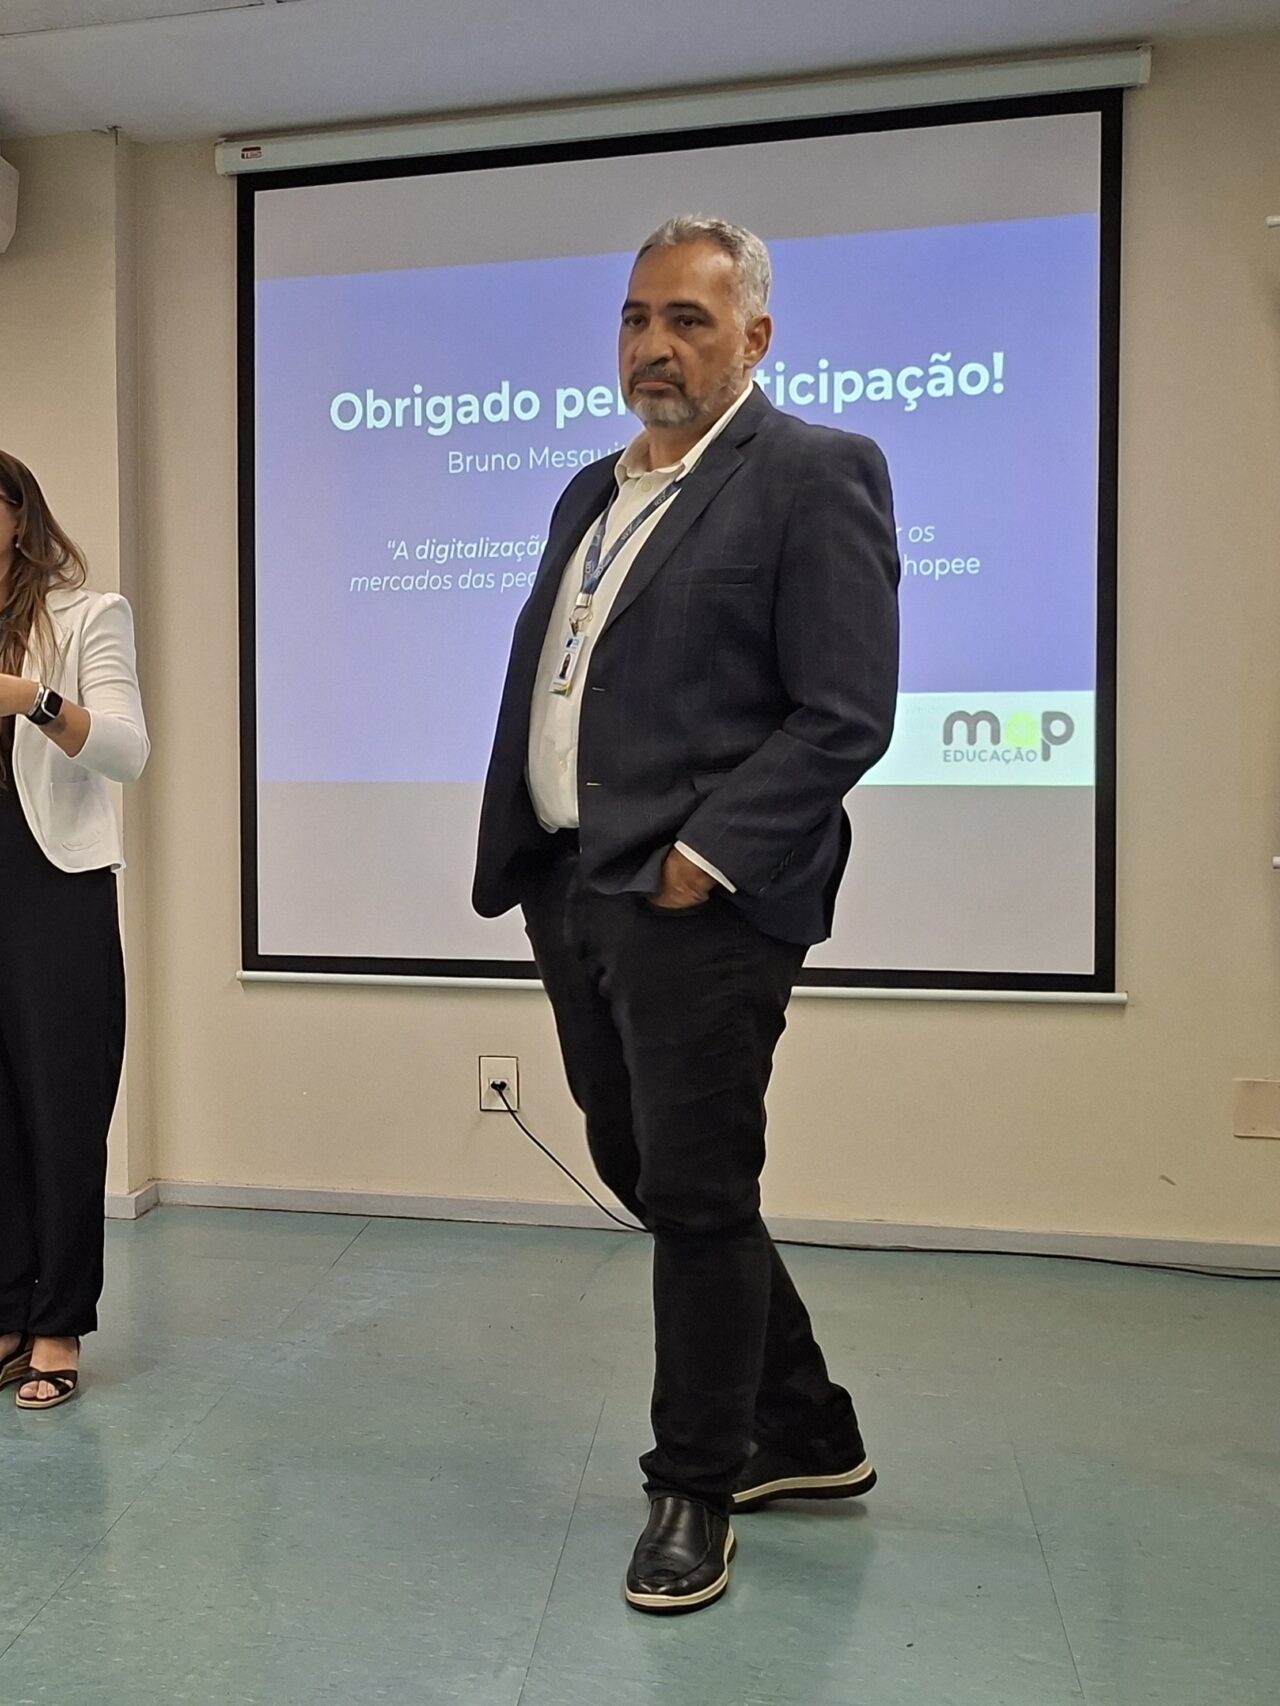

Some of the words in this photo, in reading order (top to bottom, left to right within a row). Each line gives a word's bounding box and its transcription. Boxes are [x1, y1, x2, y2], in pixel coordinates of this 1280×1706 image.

[756, 352, 1004, 414] ticipação!
[330, 380, 540, 436] Obrigado
[555, 377, 626, 428] pel
[448, 451, 521, 474] Bruno
[909, 526, 935, 542] os
[904, 554, 980, 580] hopee
[350, 571, 452, 592] mercados
[458, 569, 495, 589] das
[943, 748, 1037, 764] EDUCAÇÃO
